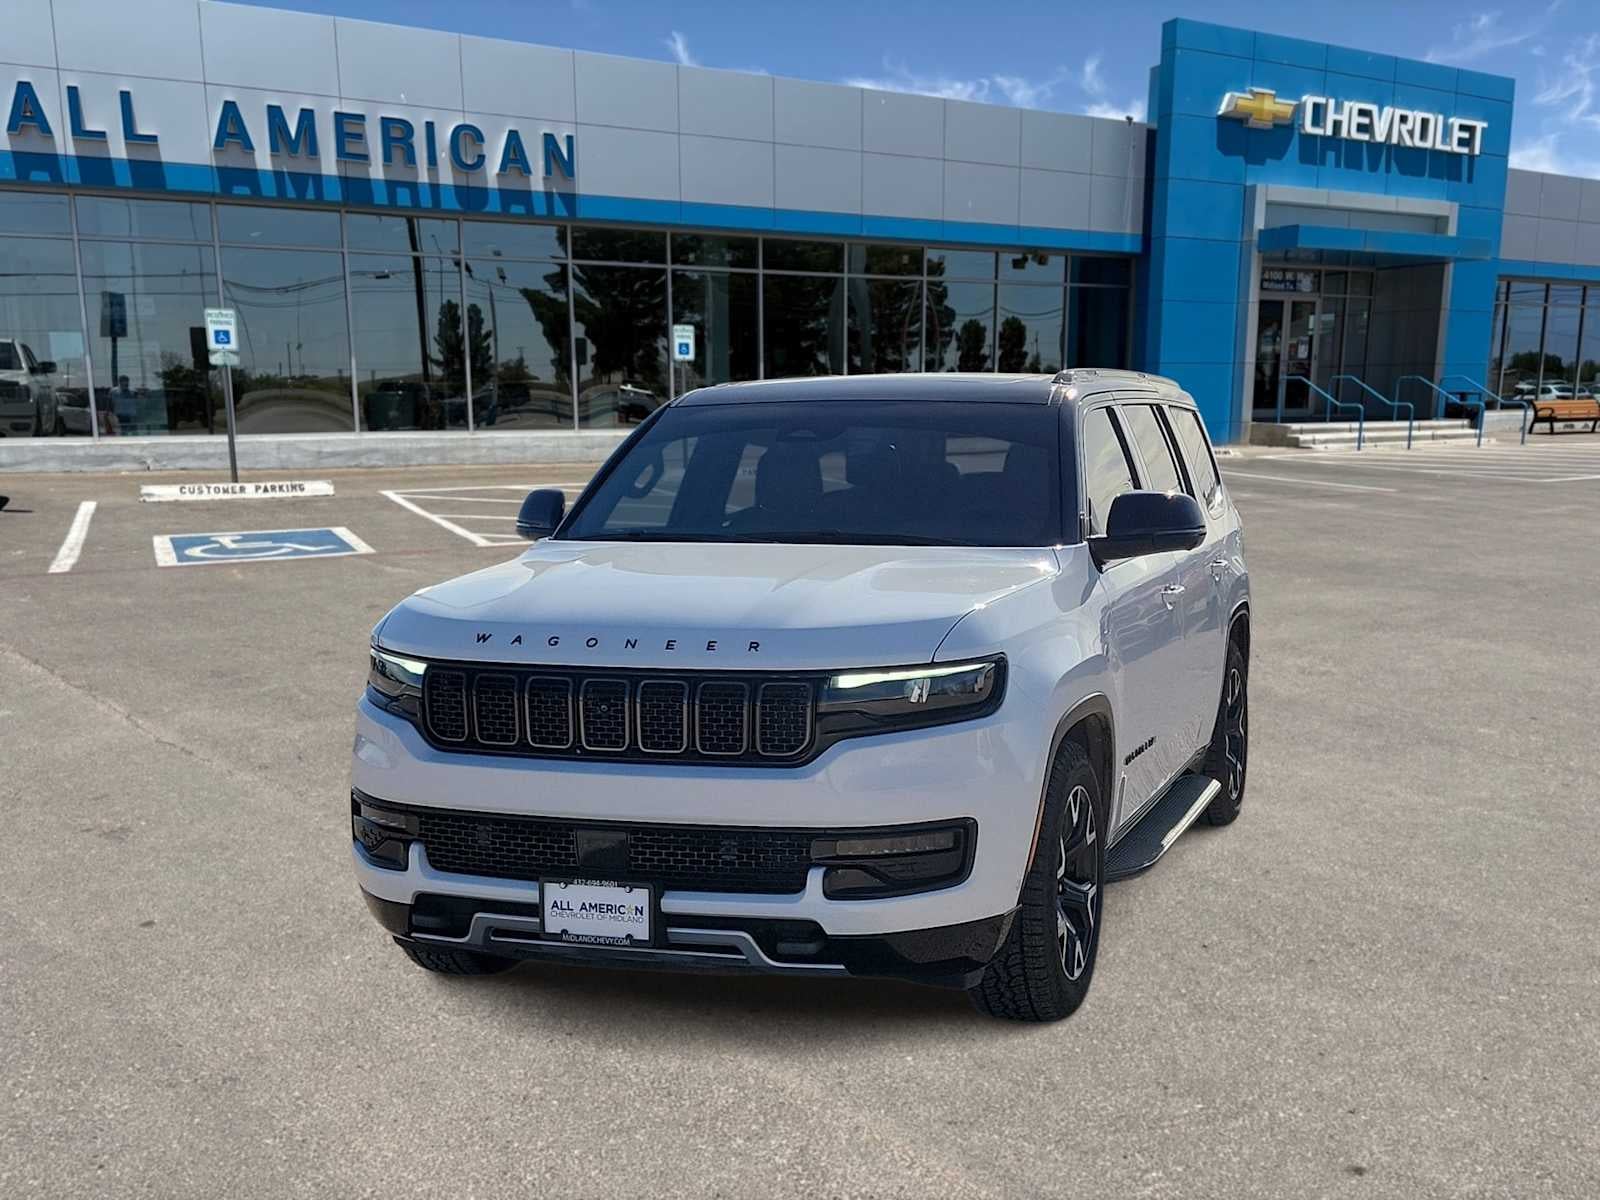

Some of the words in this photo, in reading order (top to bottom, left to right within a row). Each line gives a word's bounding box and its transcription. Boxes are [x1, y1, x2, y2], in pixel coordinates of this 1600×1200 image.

[6, 80, 158, 144] ALL
[213, 99, 576, 179] AMERICAN
[1301, 94, 1488, 155] CHEVROLET
[179, 485, 246, 495] CUSTOMER
[255, 483, 305, 493] PARKING
[476, 632, 760, 652] WAGONEER
[551, 900, 574, 911] ALL
[551, 910, 595, 920] CHEVROLET
[608, 914, 643, 923] MIDLAND
[561, 933, 631, 945] MIDLANDCHEVY.COM
